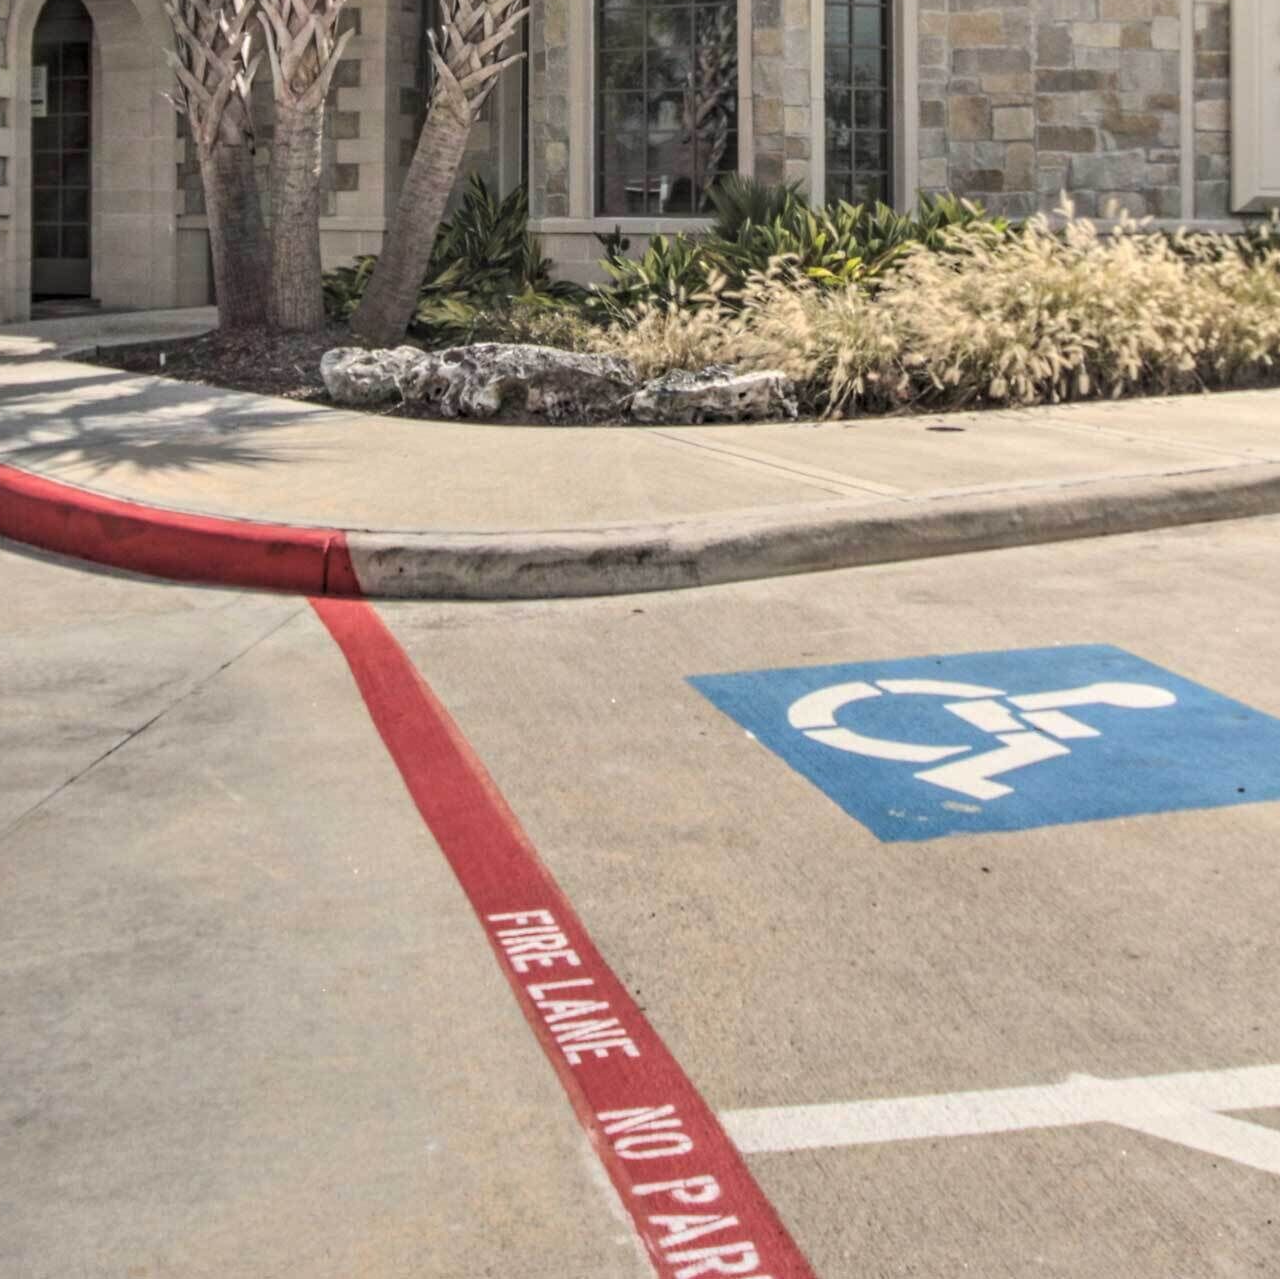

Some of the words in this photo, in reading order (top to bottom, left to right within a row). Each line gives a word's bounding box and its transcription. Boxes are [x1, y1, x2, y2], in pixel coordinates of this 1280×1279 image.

[488, 909, 581, 973] FIRE
[526, 977, 640, 1065] LANE
[597, 1104, 693, 1160] NO
[631, 1175, 772, 1279] PAR
